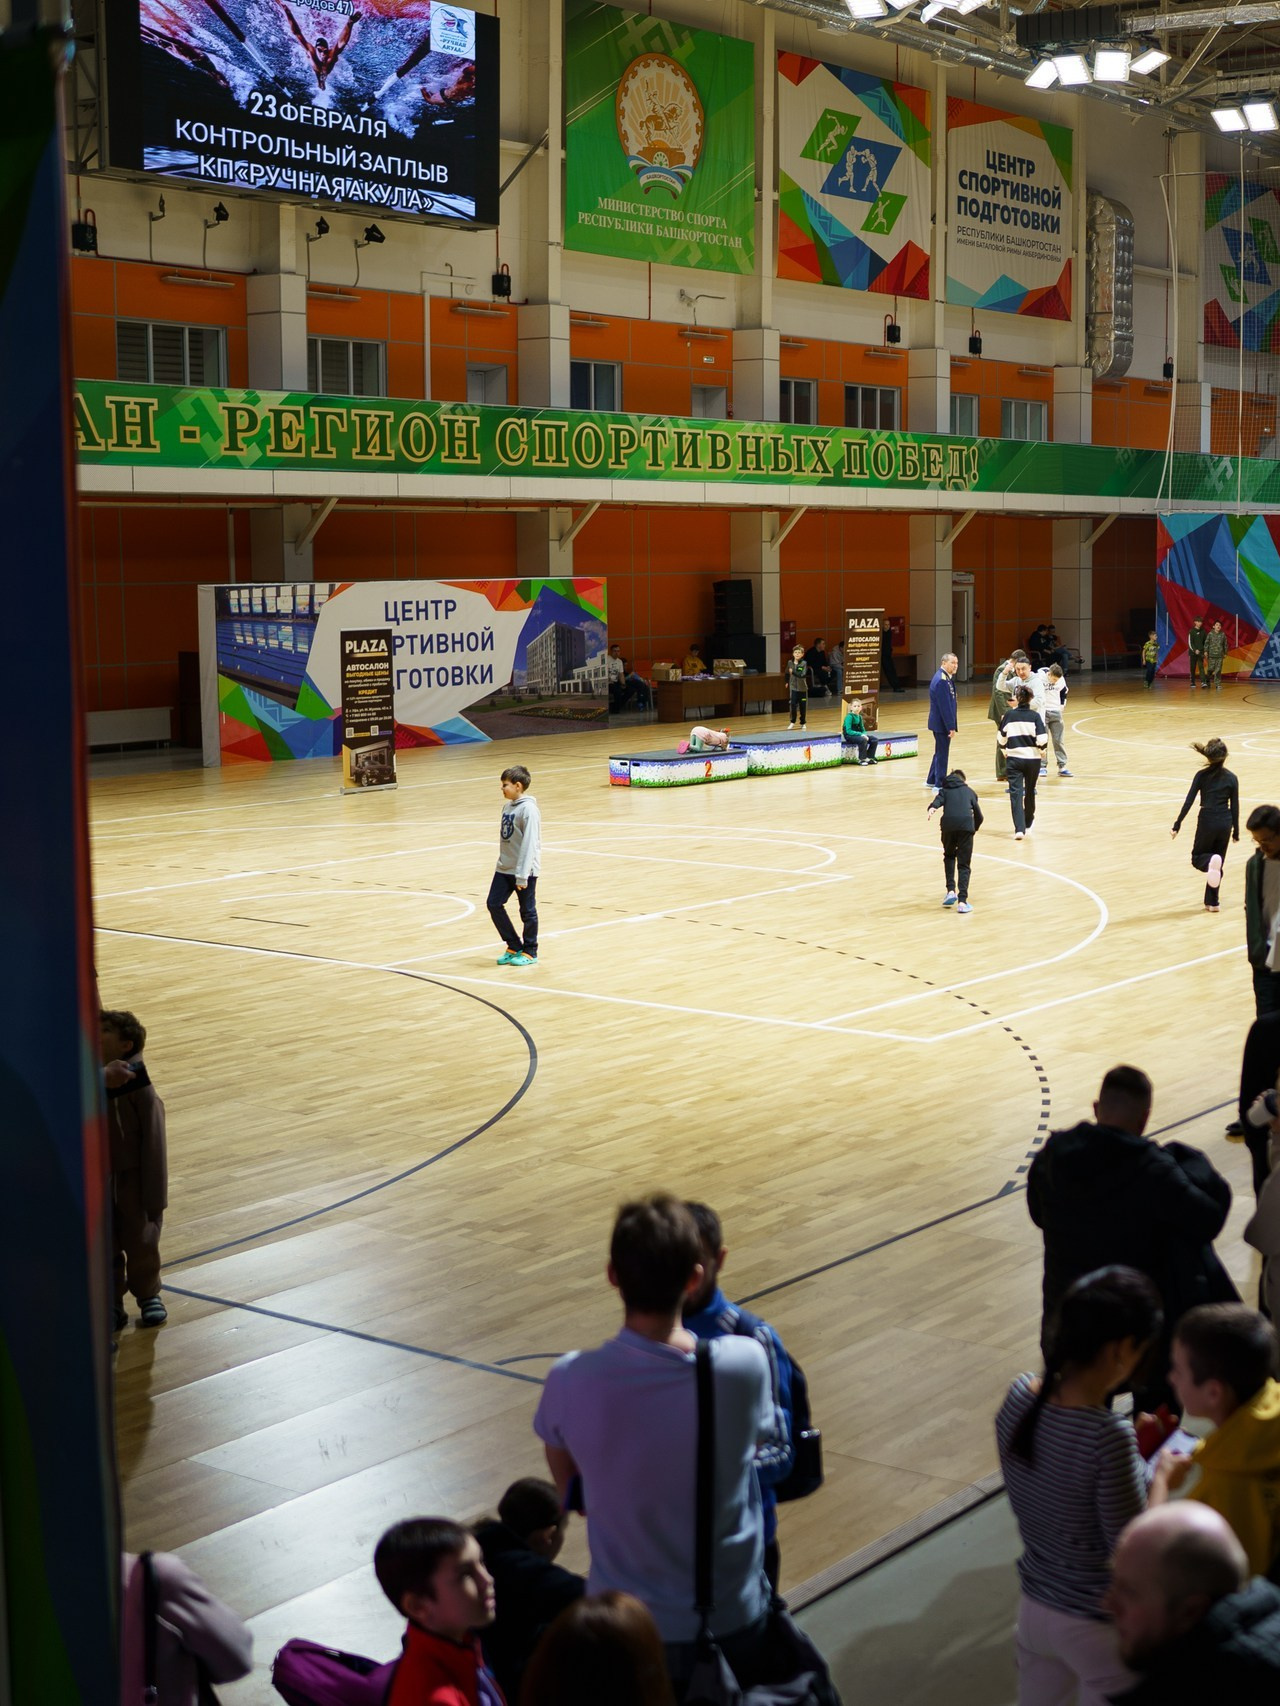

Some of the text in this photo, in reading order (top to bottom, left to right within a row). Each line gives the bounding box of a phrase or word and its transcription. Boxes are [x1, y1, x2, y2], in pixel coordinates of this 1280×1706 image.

[250, 91, 387, 139] 23 ФЕВРАЛЯ
[175, 119, 449, 183] КОНТРОЛЬНЫЙ ЗАПЛЫВ
[986, 149, 1036, 178] ЦЕНТР
[958, 169, 1062, 210] СПОРТИВНОЙ
[598, 196, 728, 230] МИНИСТЕРСТВО СПОРТА
[957, 195, 1061, 235] ПОДГОТОВКИ
[578, 211, 743, 249] РЕСПУБЛИКИ БАШКОРТОСТАН
[956, 225, 1062, 254] РЕСПУБЛИКИ БАШКОРТОСТАН
[956, 237, 976, 248] ИМЕНИ
[976, 239, 1006, 253] БАТАЛОВОЙ
[1006, 246, 1022, 256] РИМЫ
[179, 425, 201, 443] -
[219, 402, 481, 465] РЕГИОН
[495, 416, 833, 477] СПОРТИВНЫХ
[841, 438, 980, 491] ПОБЕД!
[384, 599, 457, 626] ЦЕНТР
[848, 618, 880, 629] PLAZA
[345, 639, 388, 654] PLAZA
[346, 662, 389, 671] АВТОСАЛОН
[393, 663, 494, 693] ГОТОВКИ
[705, 760, 712, 777] 2
